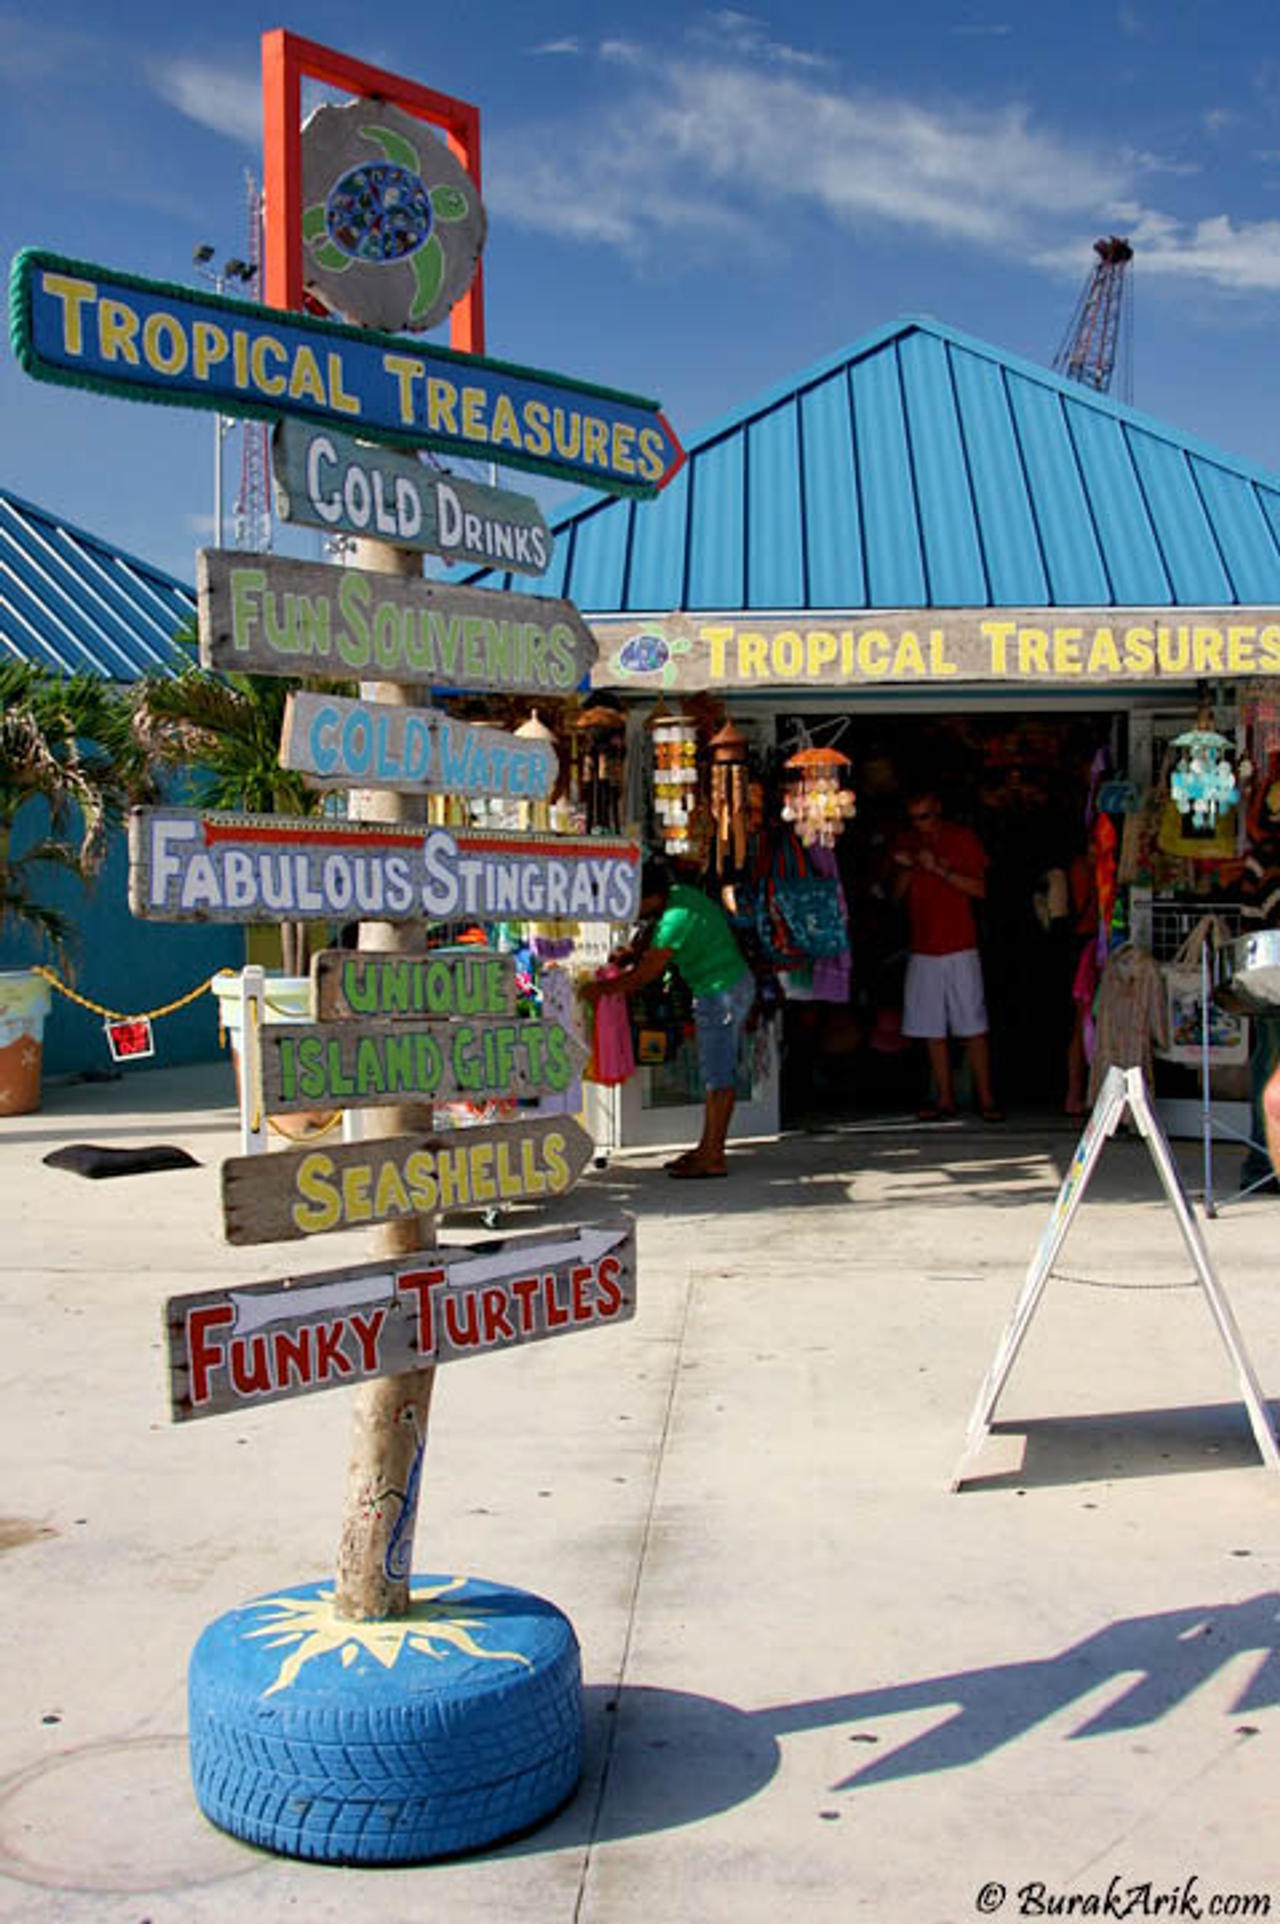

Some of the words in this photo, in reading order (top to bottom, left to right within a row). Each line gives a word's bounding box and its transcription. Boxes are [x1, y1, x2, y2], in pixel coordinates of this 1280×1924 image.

[42, 272, 360, 416] TROPICAL
[384, 354, 666, 483] TREASURES
[306, 434, 423, 538] COLD
[437, 480, 548, 570] DRINKS
[228, 569, 331, 656] FUN
[335, 572, 578, 688] SOUVENIRS
[699, 625, 957, 680] TROPICAL
[982, 620, 1280, 676] TREASURES
[309, 705, 432, 781] COLD
[438, 724, 549, 797] WATER
[149, 817, 414, 911] FABULOUS
[421, 829, 635, 920] STINGRAYS
[341, 960, 510, 1015] UNIQUE
[280, 1032, 444, 1101] ISLAND
[451, 1025, 574, 1093] GIFTS
[293, 1132, 571, 1234] SEASHELLS
[186, 1303, 387, 1407] FUNKY
[396, 1254, 624, 1356] TURTLES
